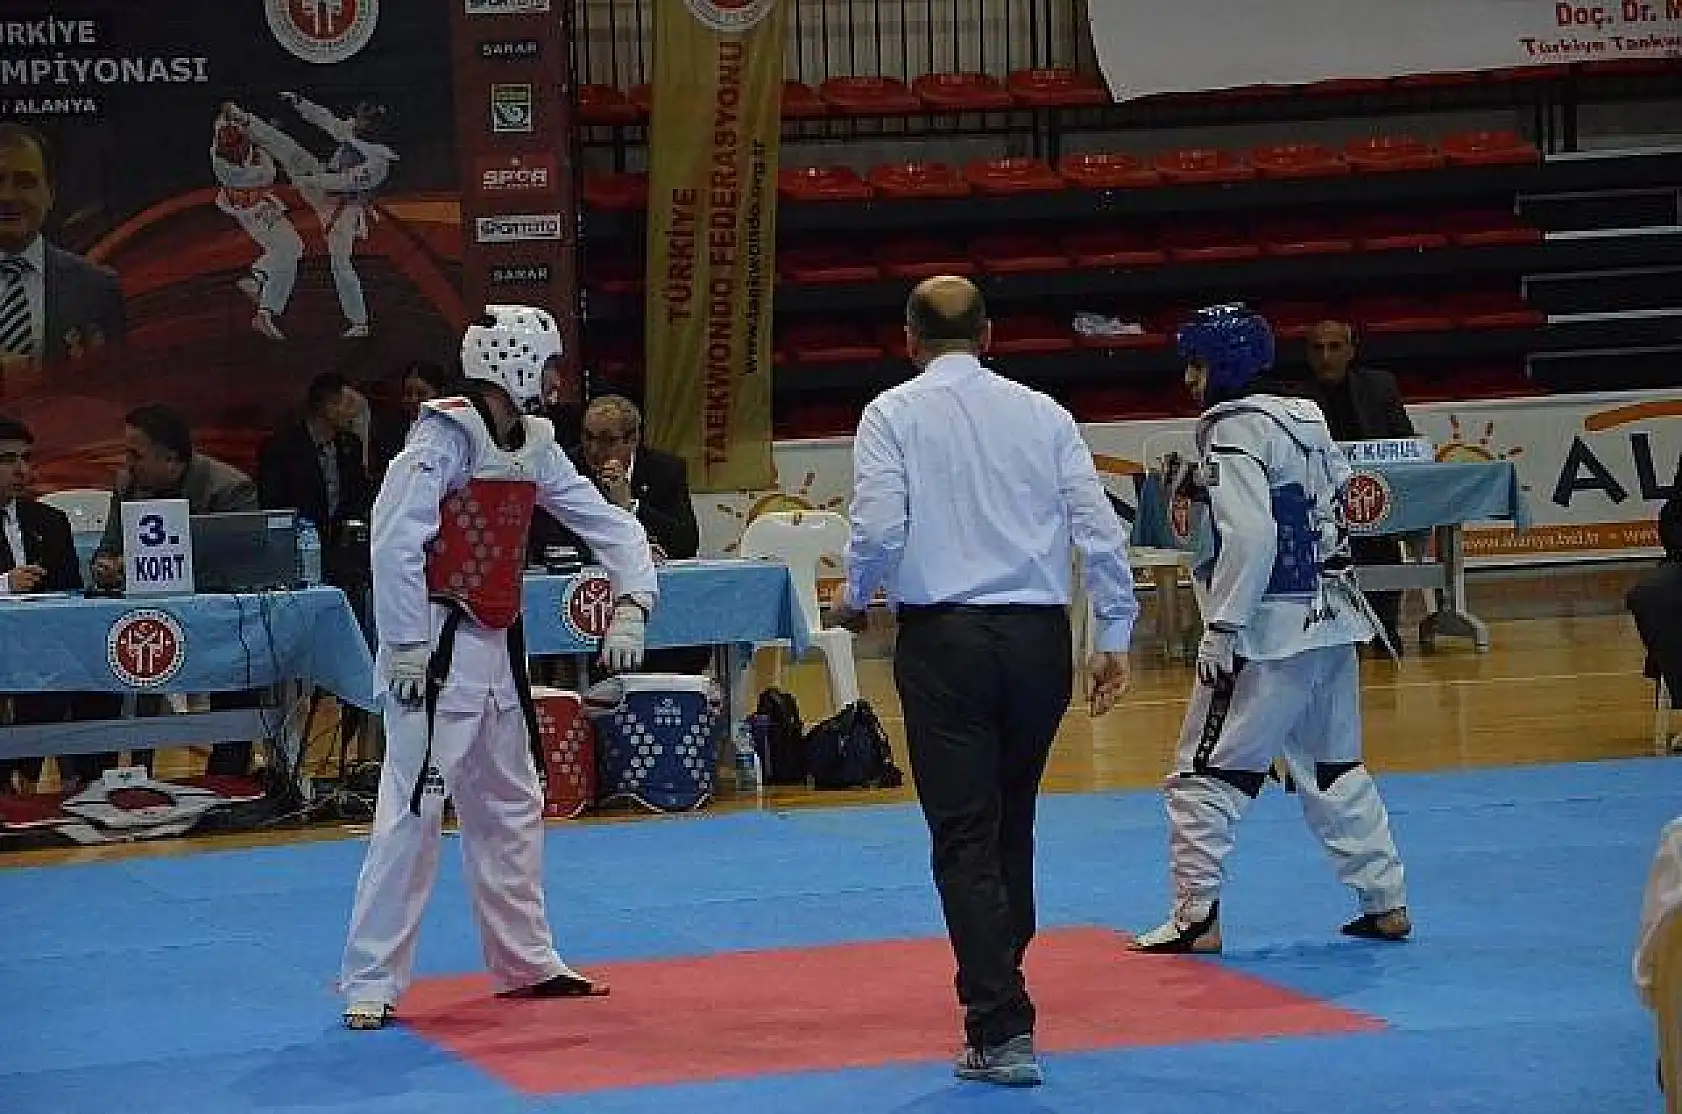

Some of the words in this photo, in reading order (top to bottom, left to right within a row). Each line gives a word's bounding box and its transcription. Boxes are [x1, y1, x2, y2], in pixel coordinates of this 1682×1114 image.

[0, 16, 96, 45] RKİYE
[2, 52, 209, 85] MPİYONASI
[708, 40, 745, 271] FEDERASYONU
[665, 187, 698, 324] TÜRKİYE
[704, 277, 736, 467] TAEKWONDO
[1553, 432, 1682, 507] AL
[138, 514, 180, 547] 3.
[136, 554, 185, 582] KORT
